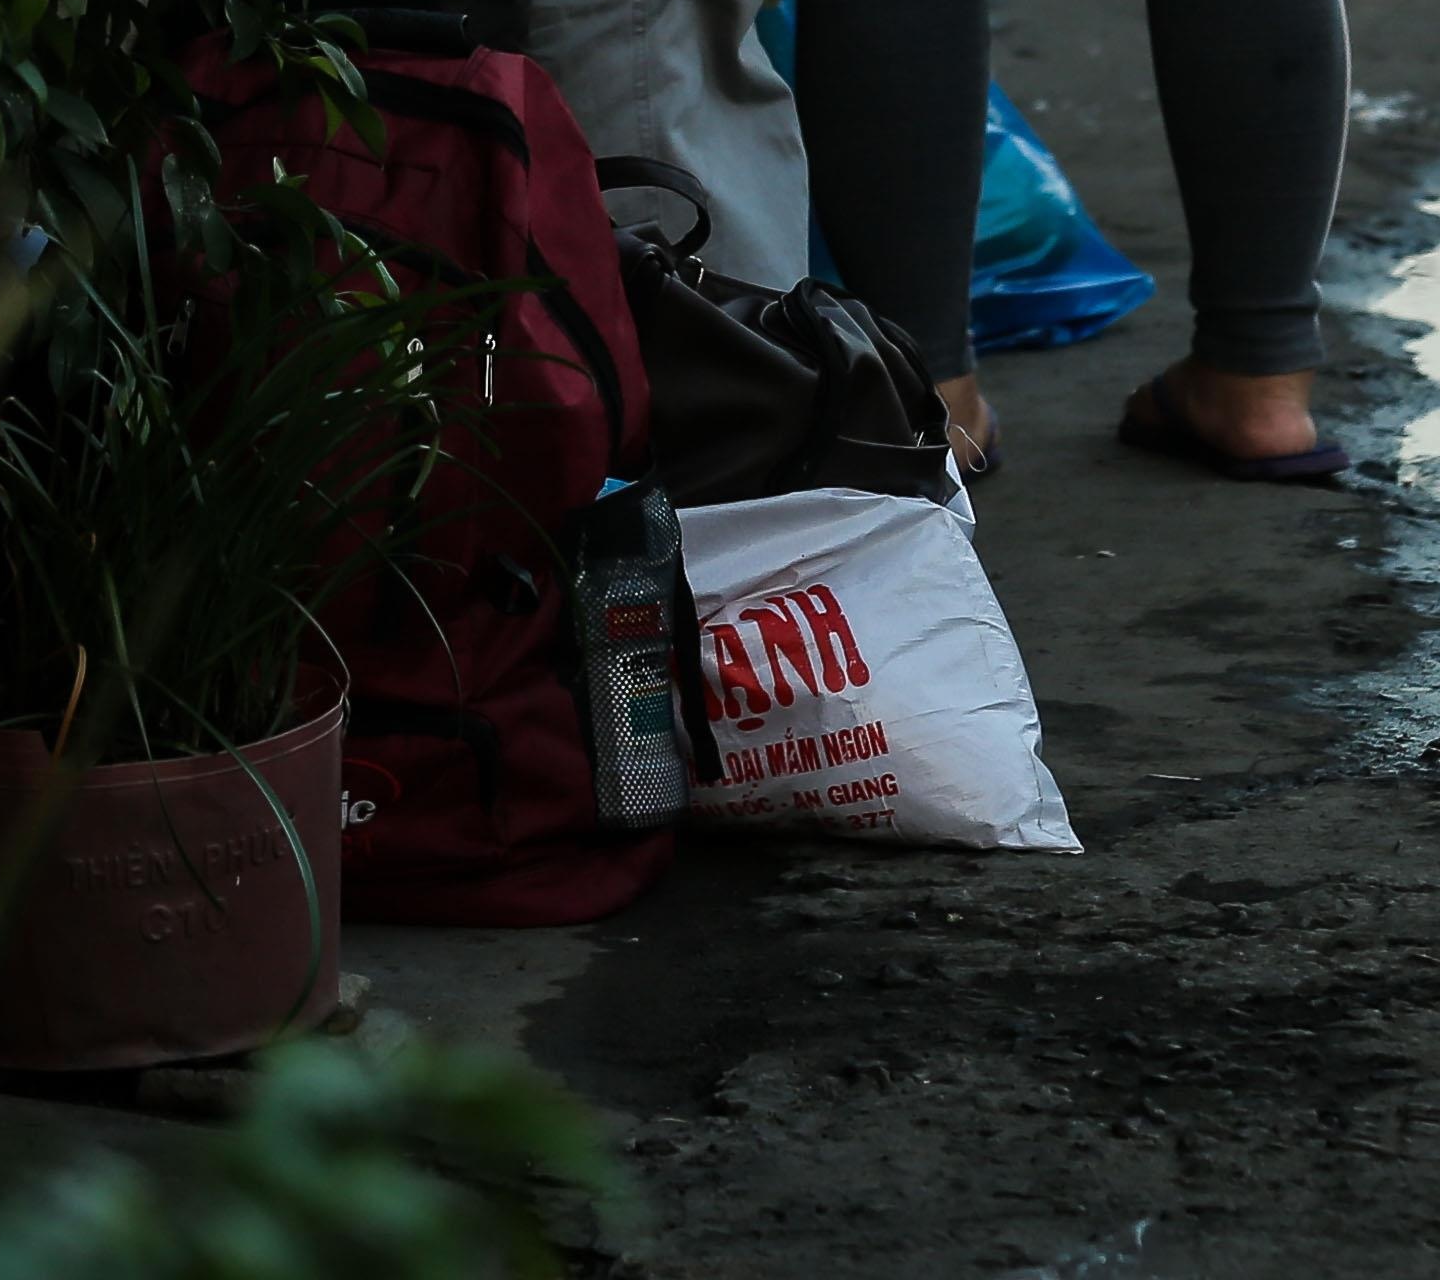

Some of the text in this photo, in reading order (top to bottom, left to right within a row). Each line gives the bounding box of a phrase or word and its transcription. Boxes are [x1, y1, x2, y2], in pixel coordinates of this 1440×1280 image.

[701, 584, 871, 731] ẠNH
[821, 720, 889, 768] NGON
[792, 789, 824, 810] AN
[827, 772, 900, 806] GIANG
